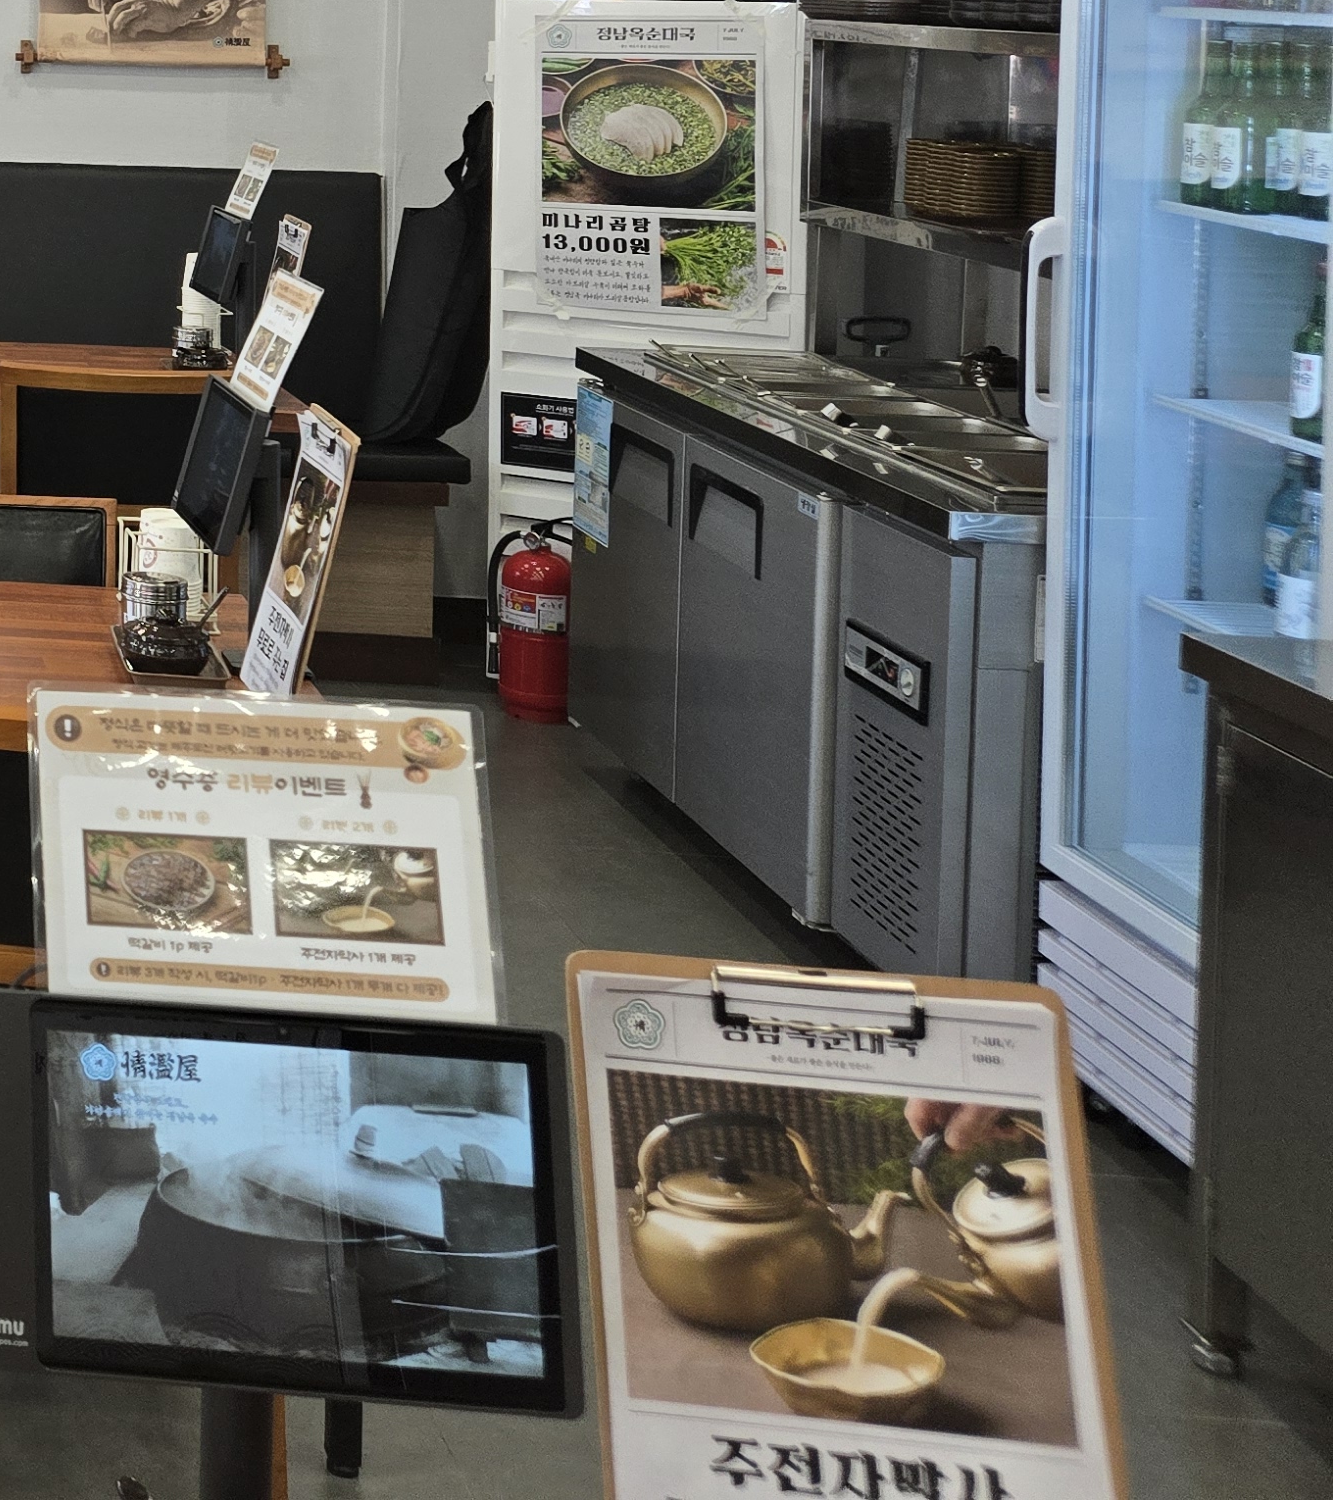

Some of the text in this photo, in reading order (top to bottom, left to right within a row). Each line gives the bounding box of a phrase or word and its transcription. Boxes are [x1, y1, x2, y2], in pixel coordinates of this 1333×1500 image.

[596, 26, 696, 42] 정남옥순대국
[541, 211, 652, 234] 미나리곰탕
[541, 232, 652, 257] 13,000원
[147, 766, 348, 798] 영수증 리뷰이벤트
[709, 1433, 1015, 1500] 주전자막사
